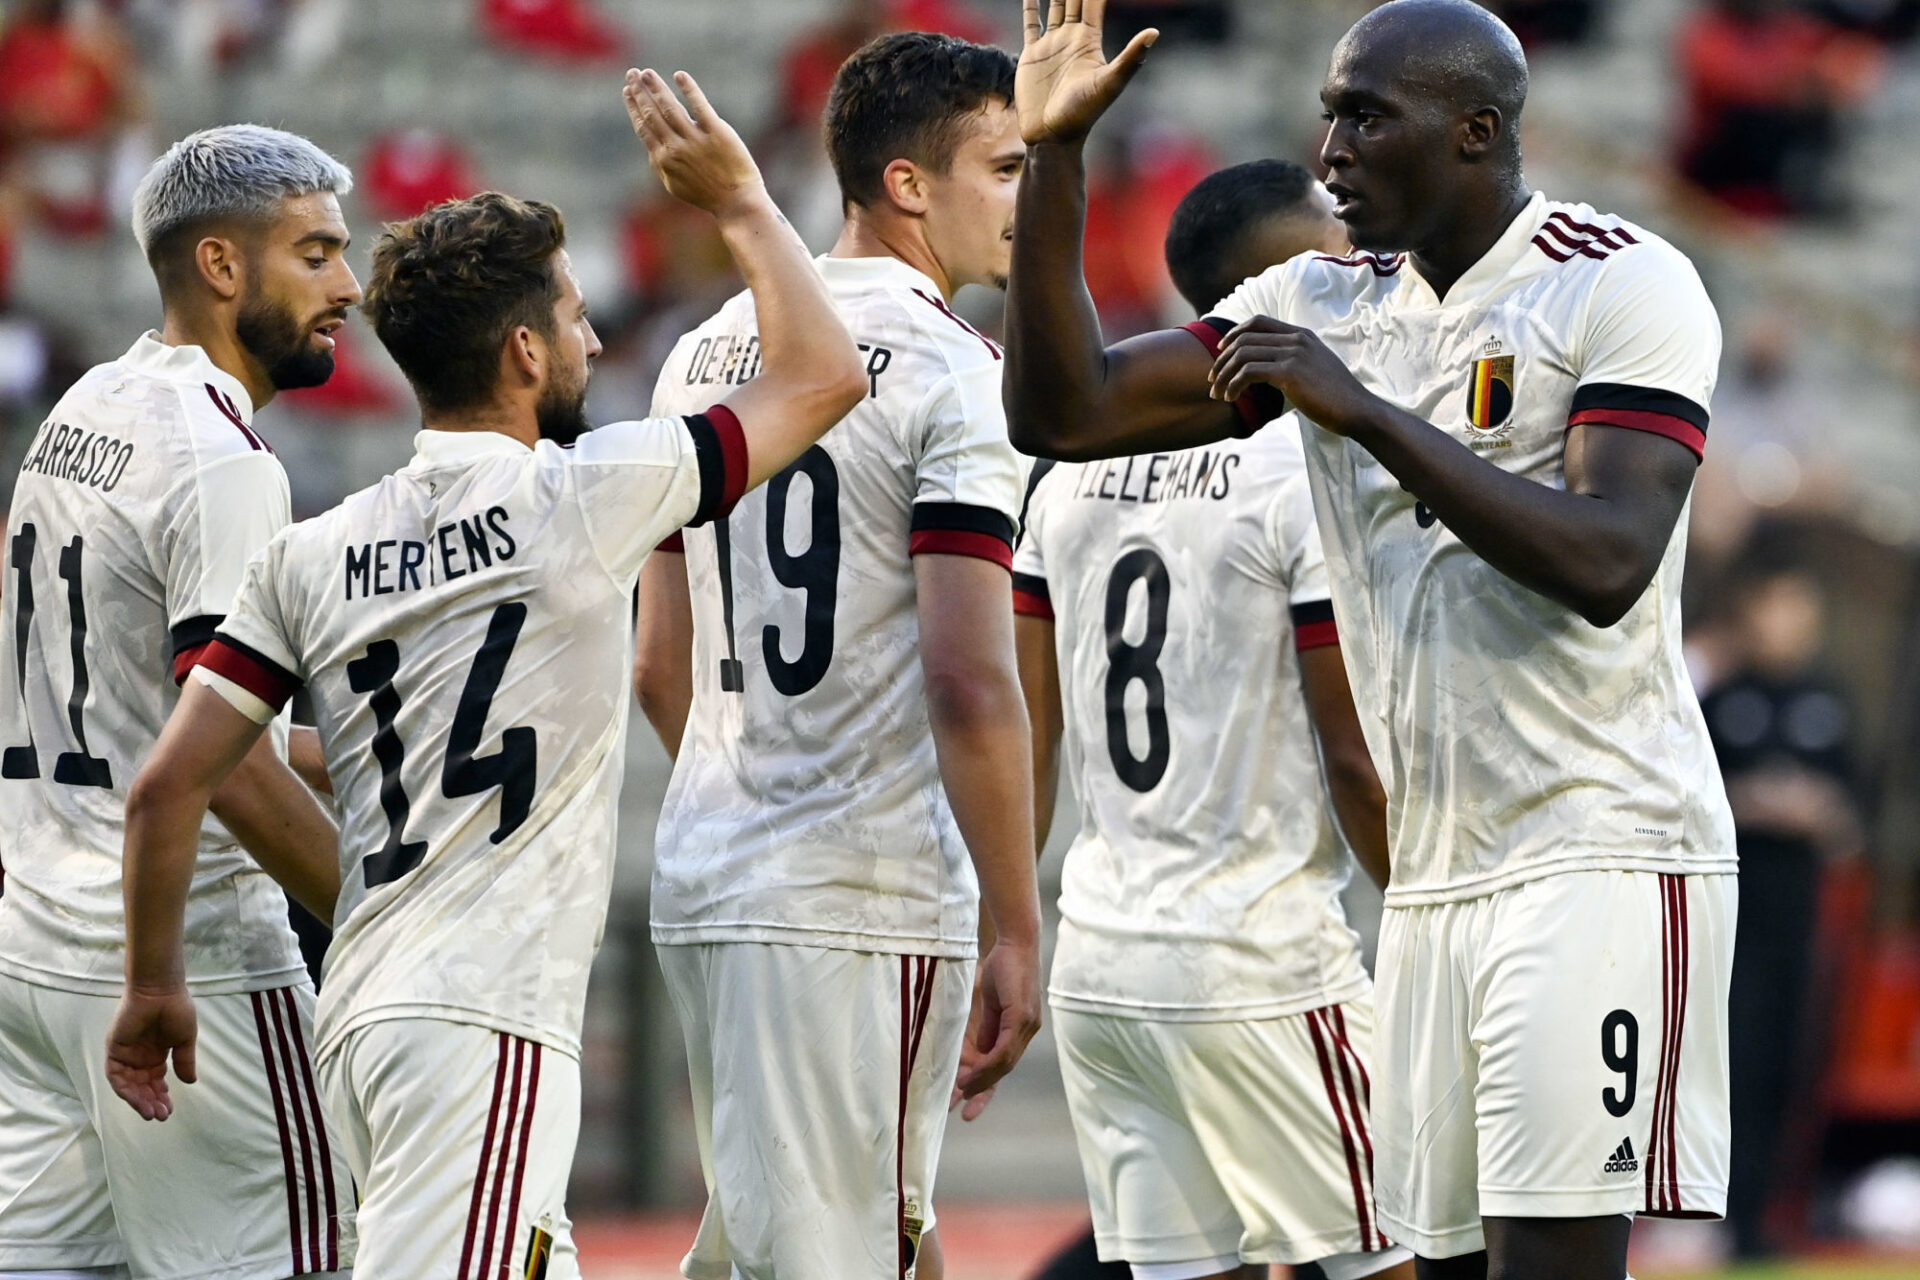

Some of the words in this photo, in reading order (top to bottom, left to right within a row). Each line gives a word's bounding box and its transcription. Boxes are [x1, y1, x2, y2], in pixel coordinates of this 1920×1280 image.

[22, 422, 134, 493] CARRASCO
[345, 505, 516, 600] MERTENS
[714, 443, 841, 697] 19
[1, 523, 113, 789] 11
[1104, 548, 1170, 793] 8
[346, 601, 537, 889] 14
[1601, 1009, 1639, 1117] 9
[1604, 1160, 1638, 1173] adidas
